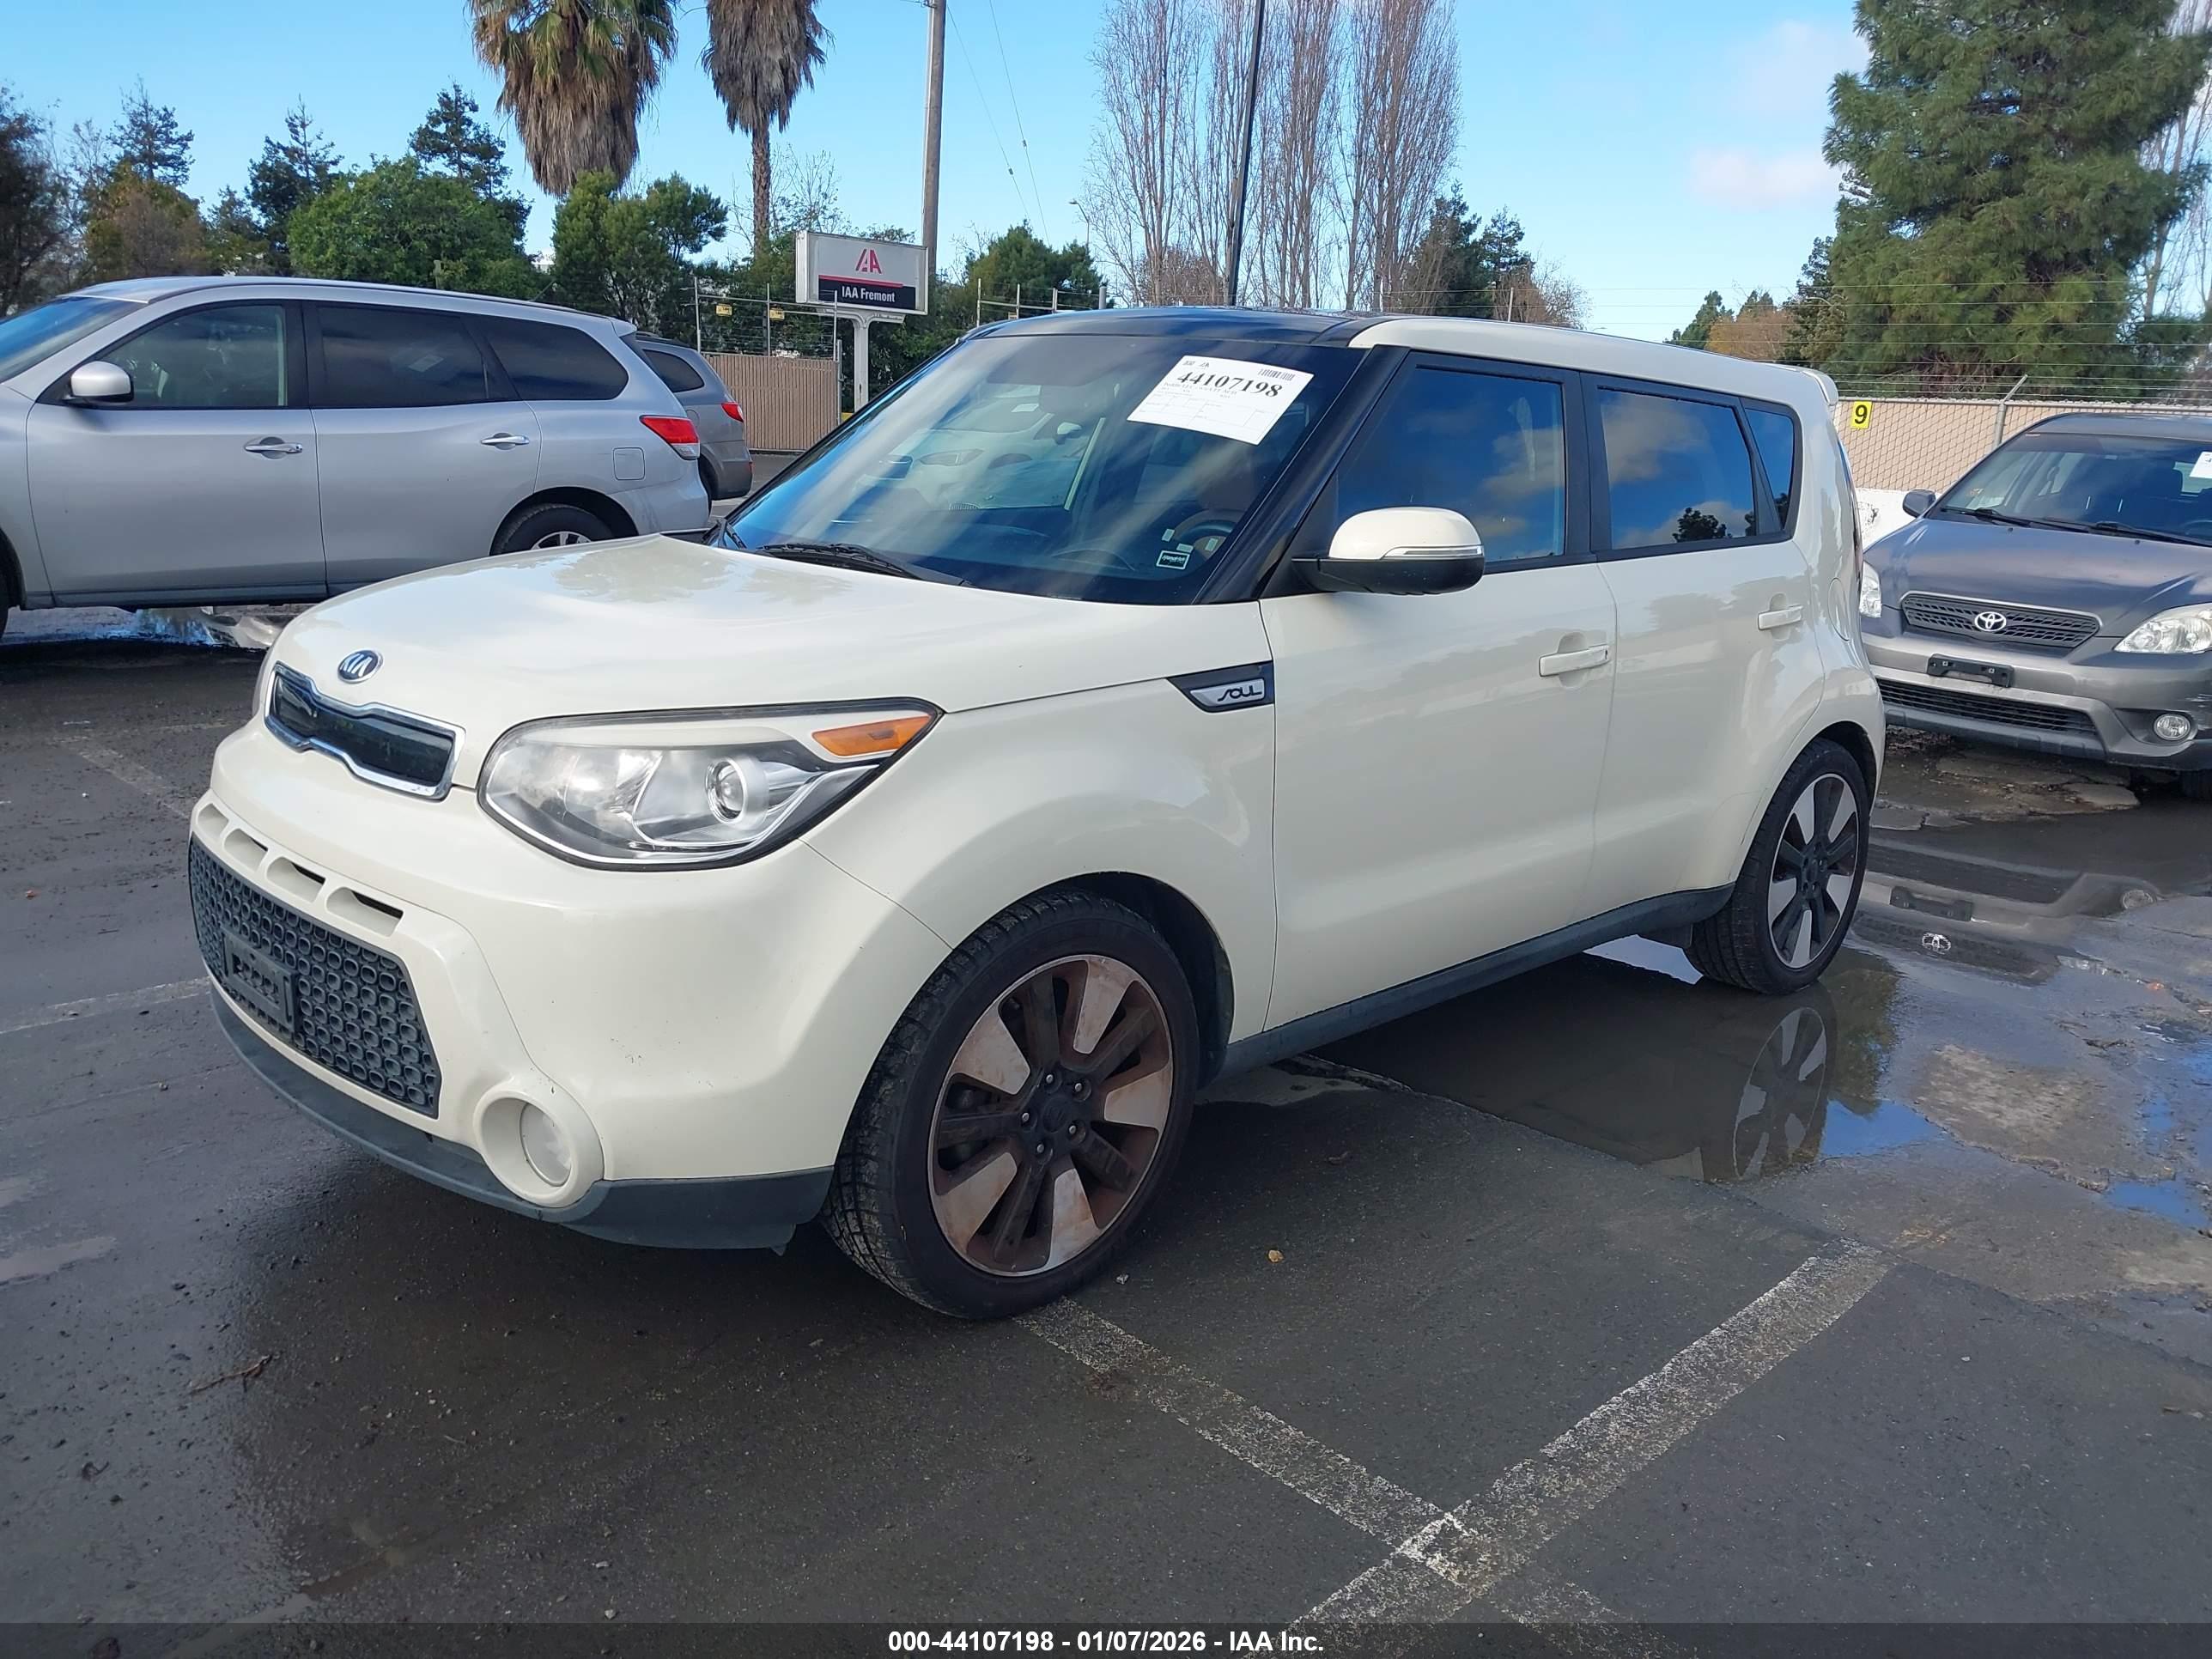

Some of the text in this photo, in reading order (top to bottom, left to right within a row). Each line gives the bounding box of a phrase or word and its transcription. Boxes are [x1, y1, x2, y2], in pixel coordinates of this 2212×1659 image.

[842, 285, 895, 302] IAA Fremont
[1177, 371, 1283, 398] 44107198
[1854, 404, 1868, 424] 9
